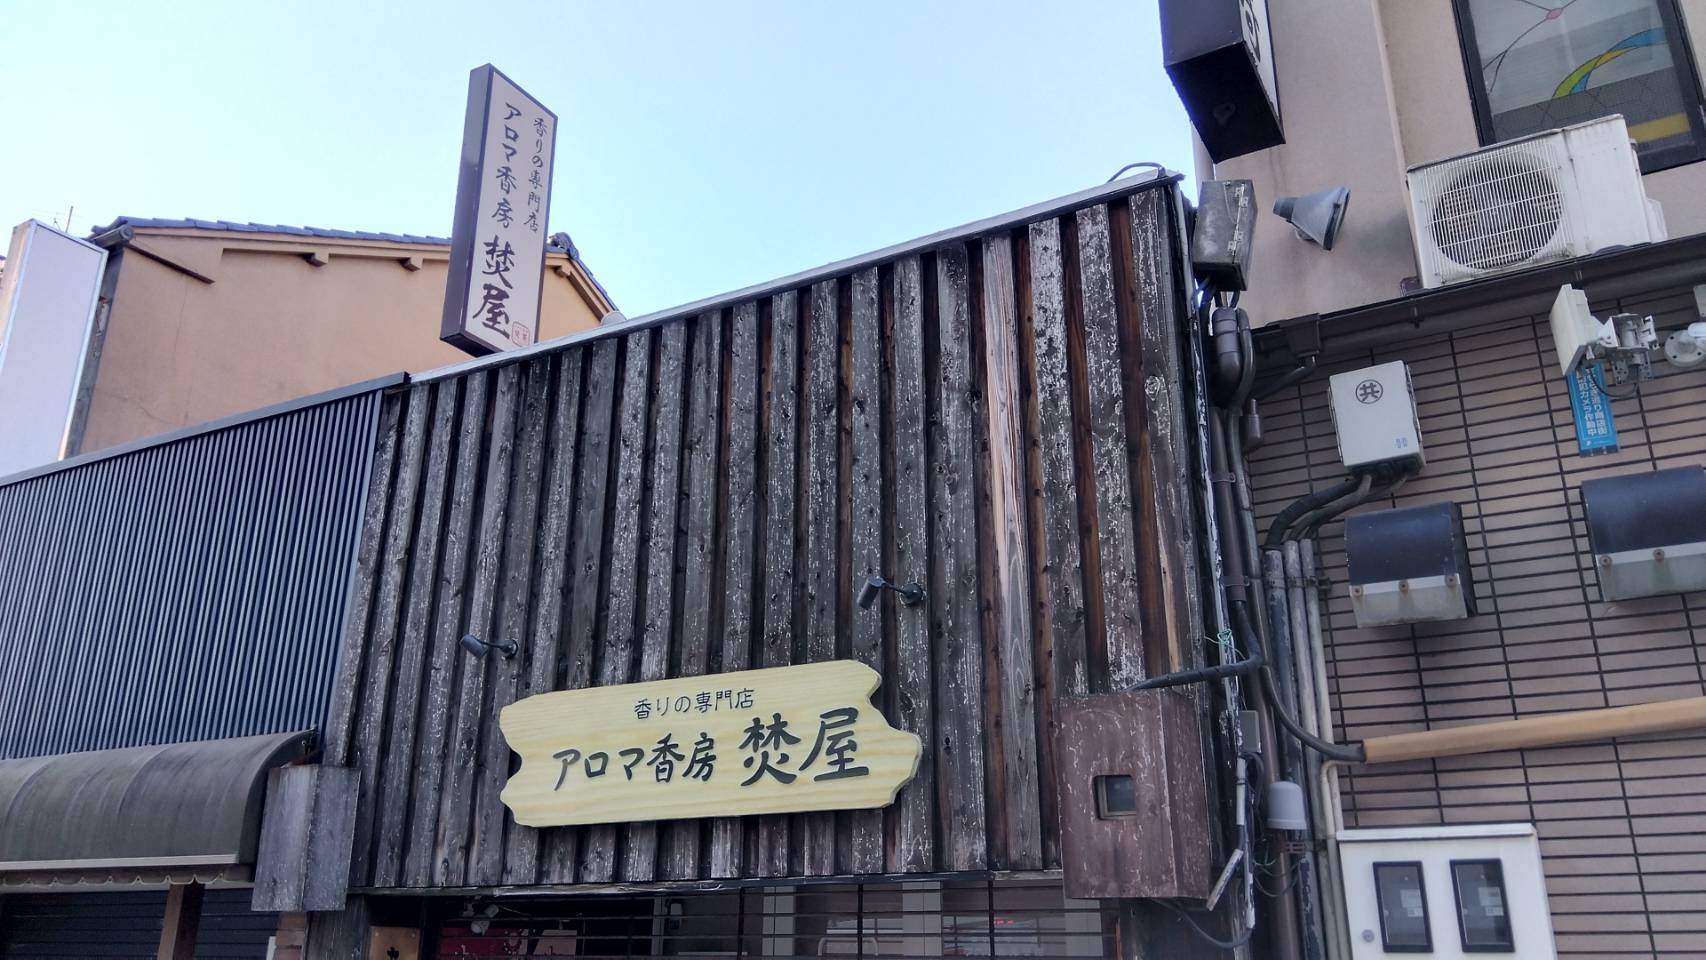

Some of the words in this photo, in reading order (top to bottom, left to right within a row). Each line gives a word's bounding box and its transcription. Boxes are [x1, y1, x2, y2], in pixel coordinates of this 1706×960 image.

[491, 102, 522, 229] アロマ香房
[523, 117, 547, 233] 香りの専門店
[472, 234, 516, 340] 焚屋
[552, 732, 718, 791] アロマ香房
[739, 706, 870, 787] 焚屋
[633, 687, 756, 720] 香りの専門店
